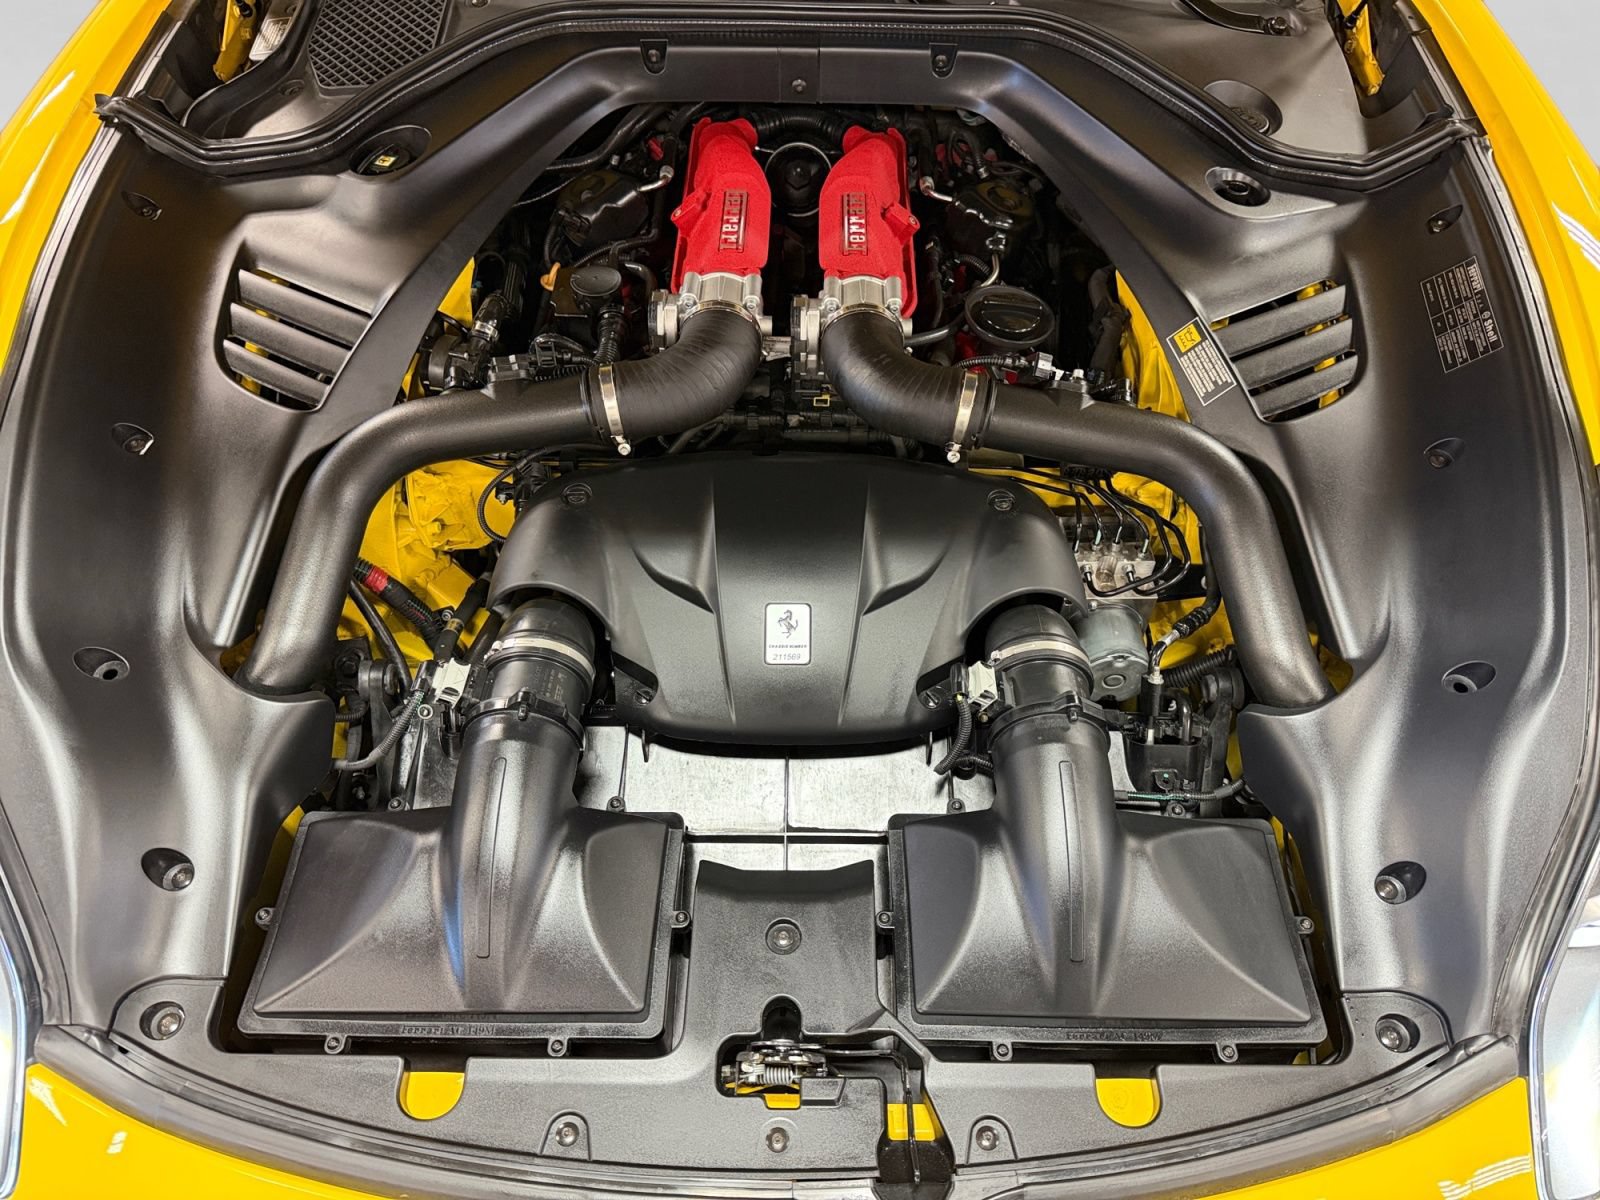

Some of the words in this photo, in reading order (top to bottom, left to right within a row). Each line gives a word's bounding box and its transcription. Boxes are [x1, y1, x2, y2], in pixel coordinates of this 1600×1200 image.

[720, 190, 748, 250] Ferrari
[843, 193, 867, 252] Ferrari
[1467, 263, 1484, 293] Ferrari
[1483, 319, 1499, 343] Shell
[772, 653, 801, 661] 211569
